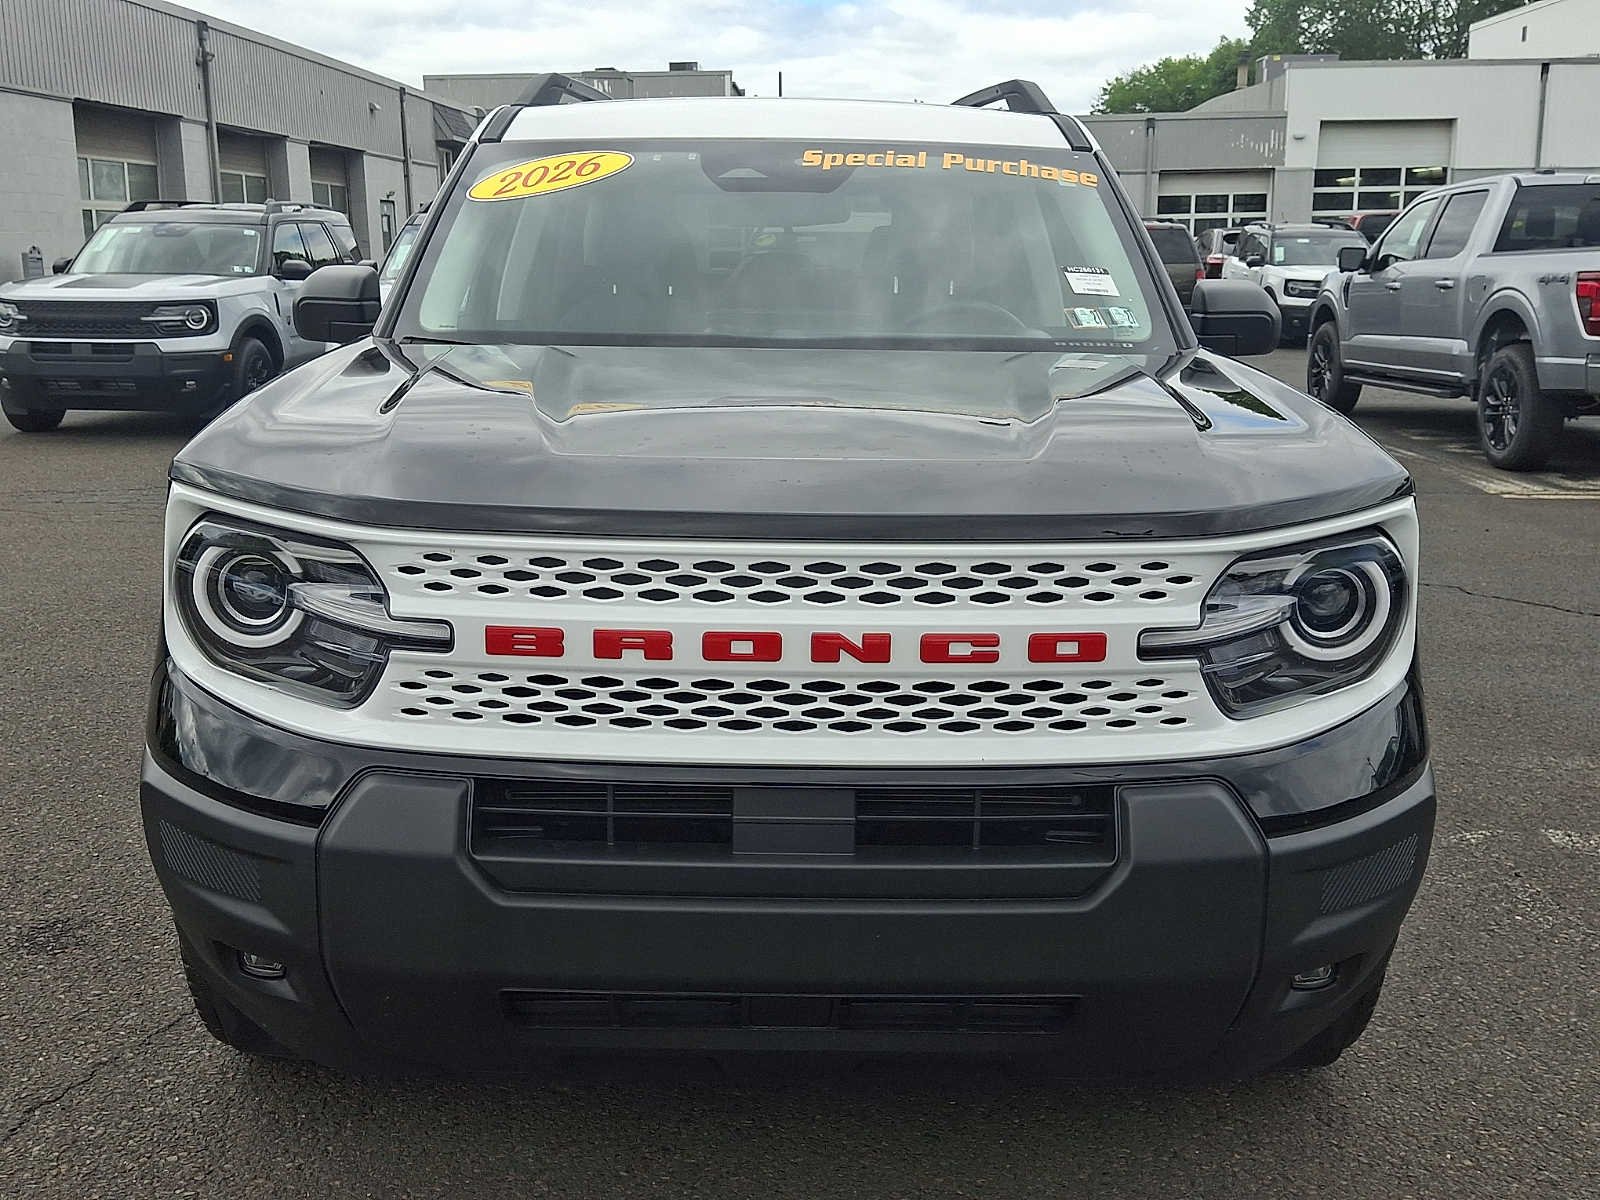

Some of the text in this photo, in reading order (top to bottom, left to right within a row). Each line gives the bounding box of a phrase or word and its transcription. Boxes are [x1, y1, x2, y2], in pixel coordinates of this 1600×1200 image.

[493, 155, 606, 196] 2026
[803, 150, 1098, 187] Special Purchase
[485, 624, 1108, 664] BRONCO
